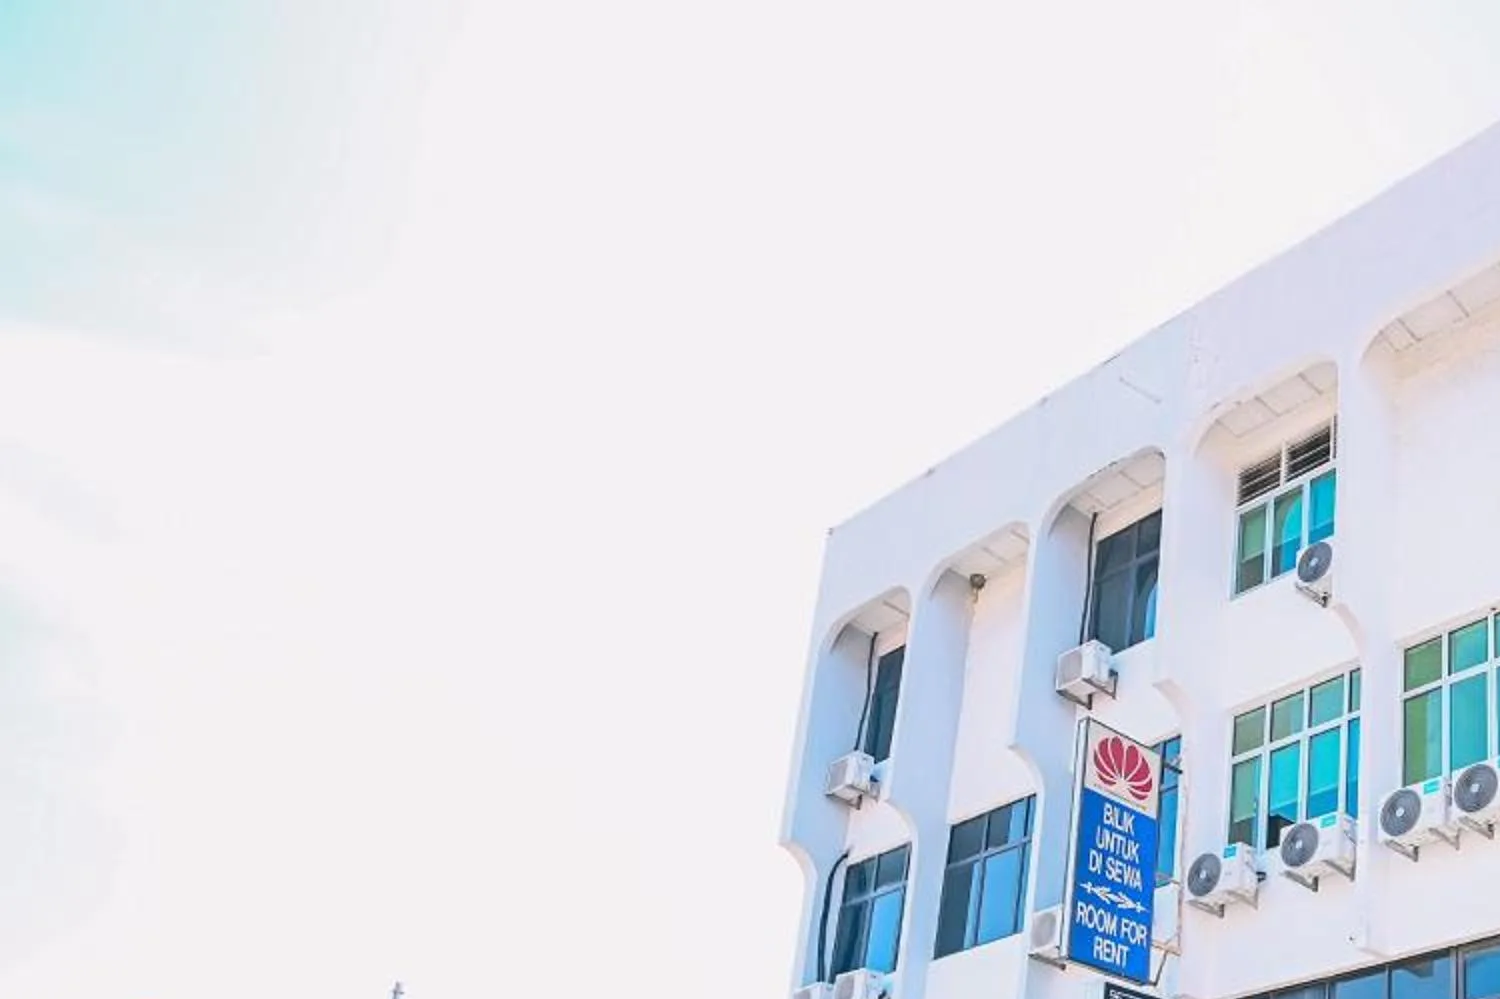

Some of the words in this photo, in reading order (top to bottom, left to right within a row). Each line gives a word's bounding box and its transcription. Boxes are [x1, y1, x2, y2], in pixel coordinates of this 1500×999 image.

[1103, 803, 1135, 836] BILIK
[1096, 826, 1139, 863] UNTUK
[1088, 848, 1102, 875] DI
[1105, 857, 1143, 893] SEWA
[1076, 901, 1118, 937] ROOM
[1120, 918, 1148, 949] FOR
[1093, 937, 1130, 968] RENT
